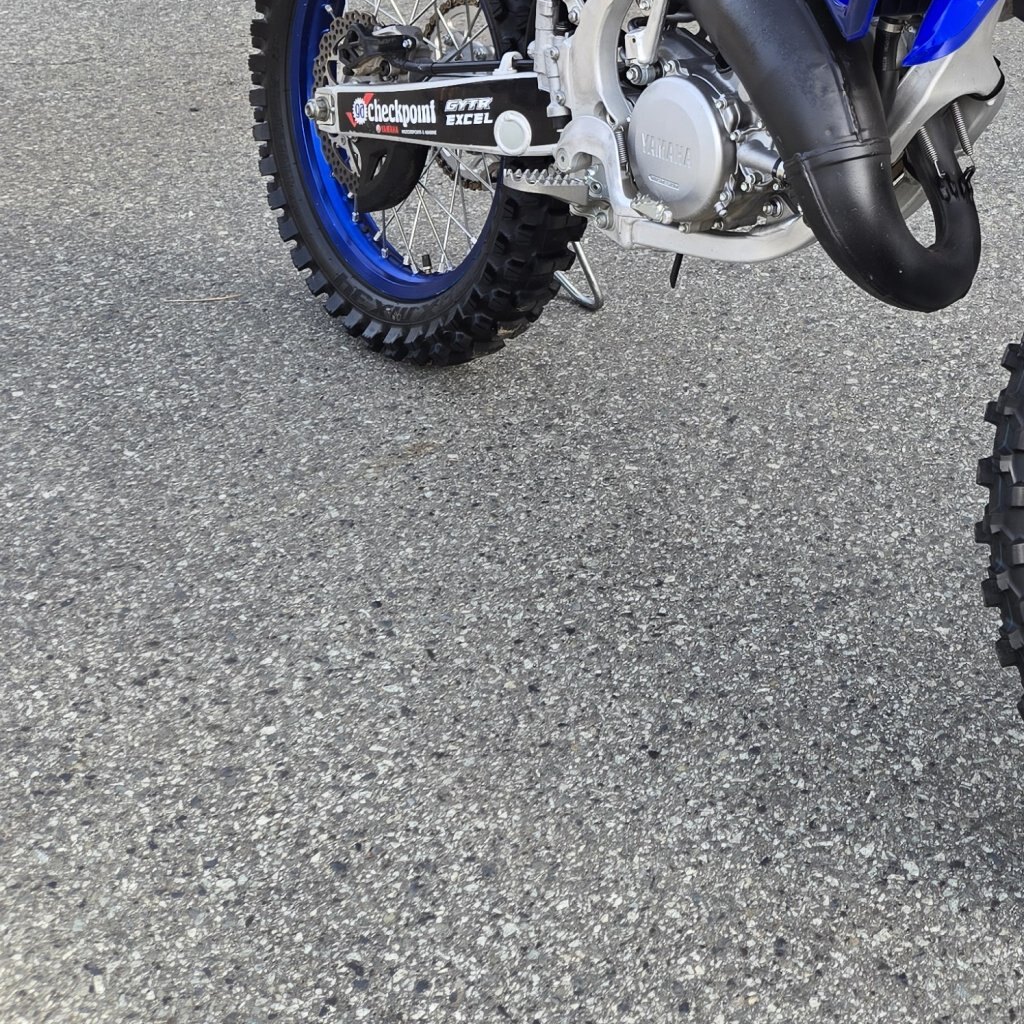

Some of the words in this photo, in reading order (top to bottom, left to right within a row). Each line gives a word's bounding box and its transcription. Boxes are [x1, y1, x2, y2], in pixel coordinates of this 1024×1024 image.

[367, 99, 436, 127] checkpoint
[444, 97, 493, 112] GYTR
[446, 113, 493, 126] EXCEL
[642, 133, 691, 168] YAMAHA
